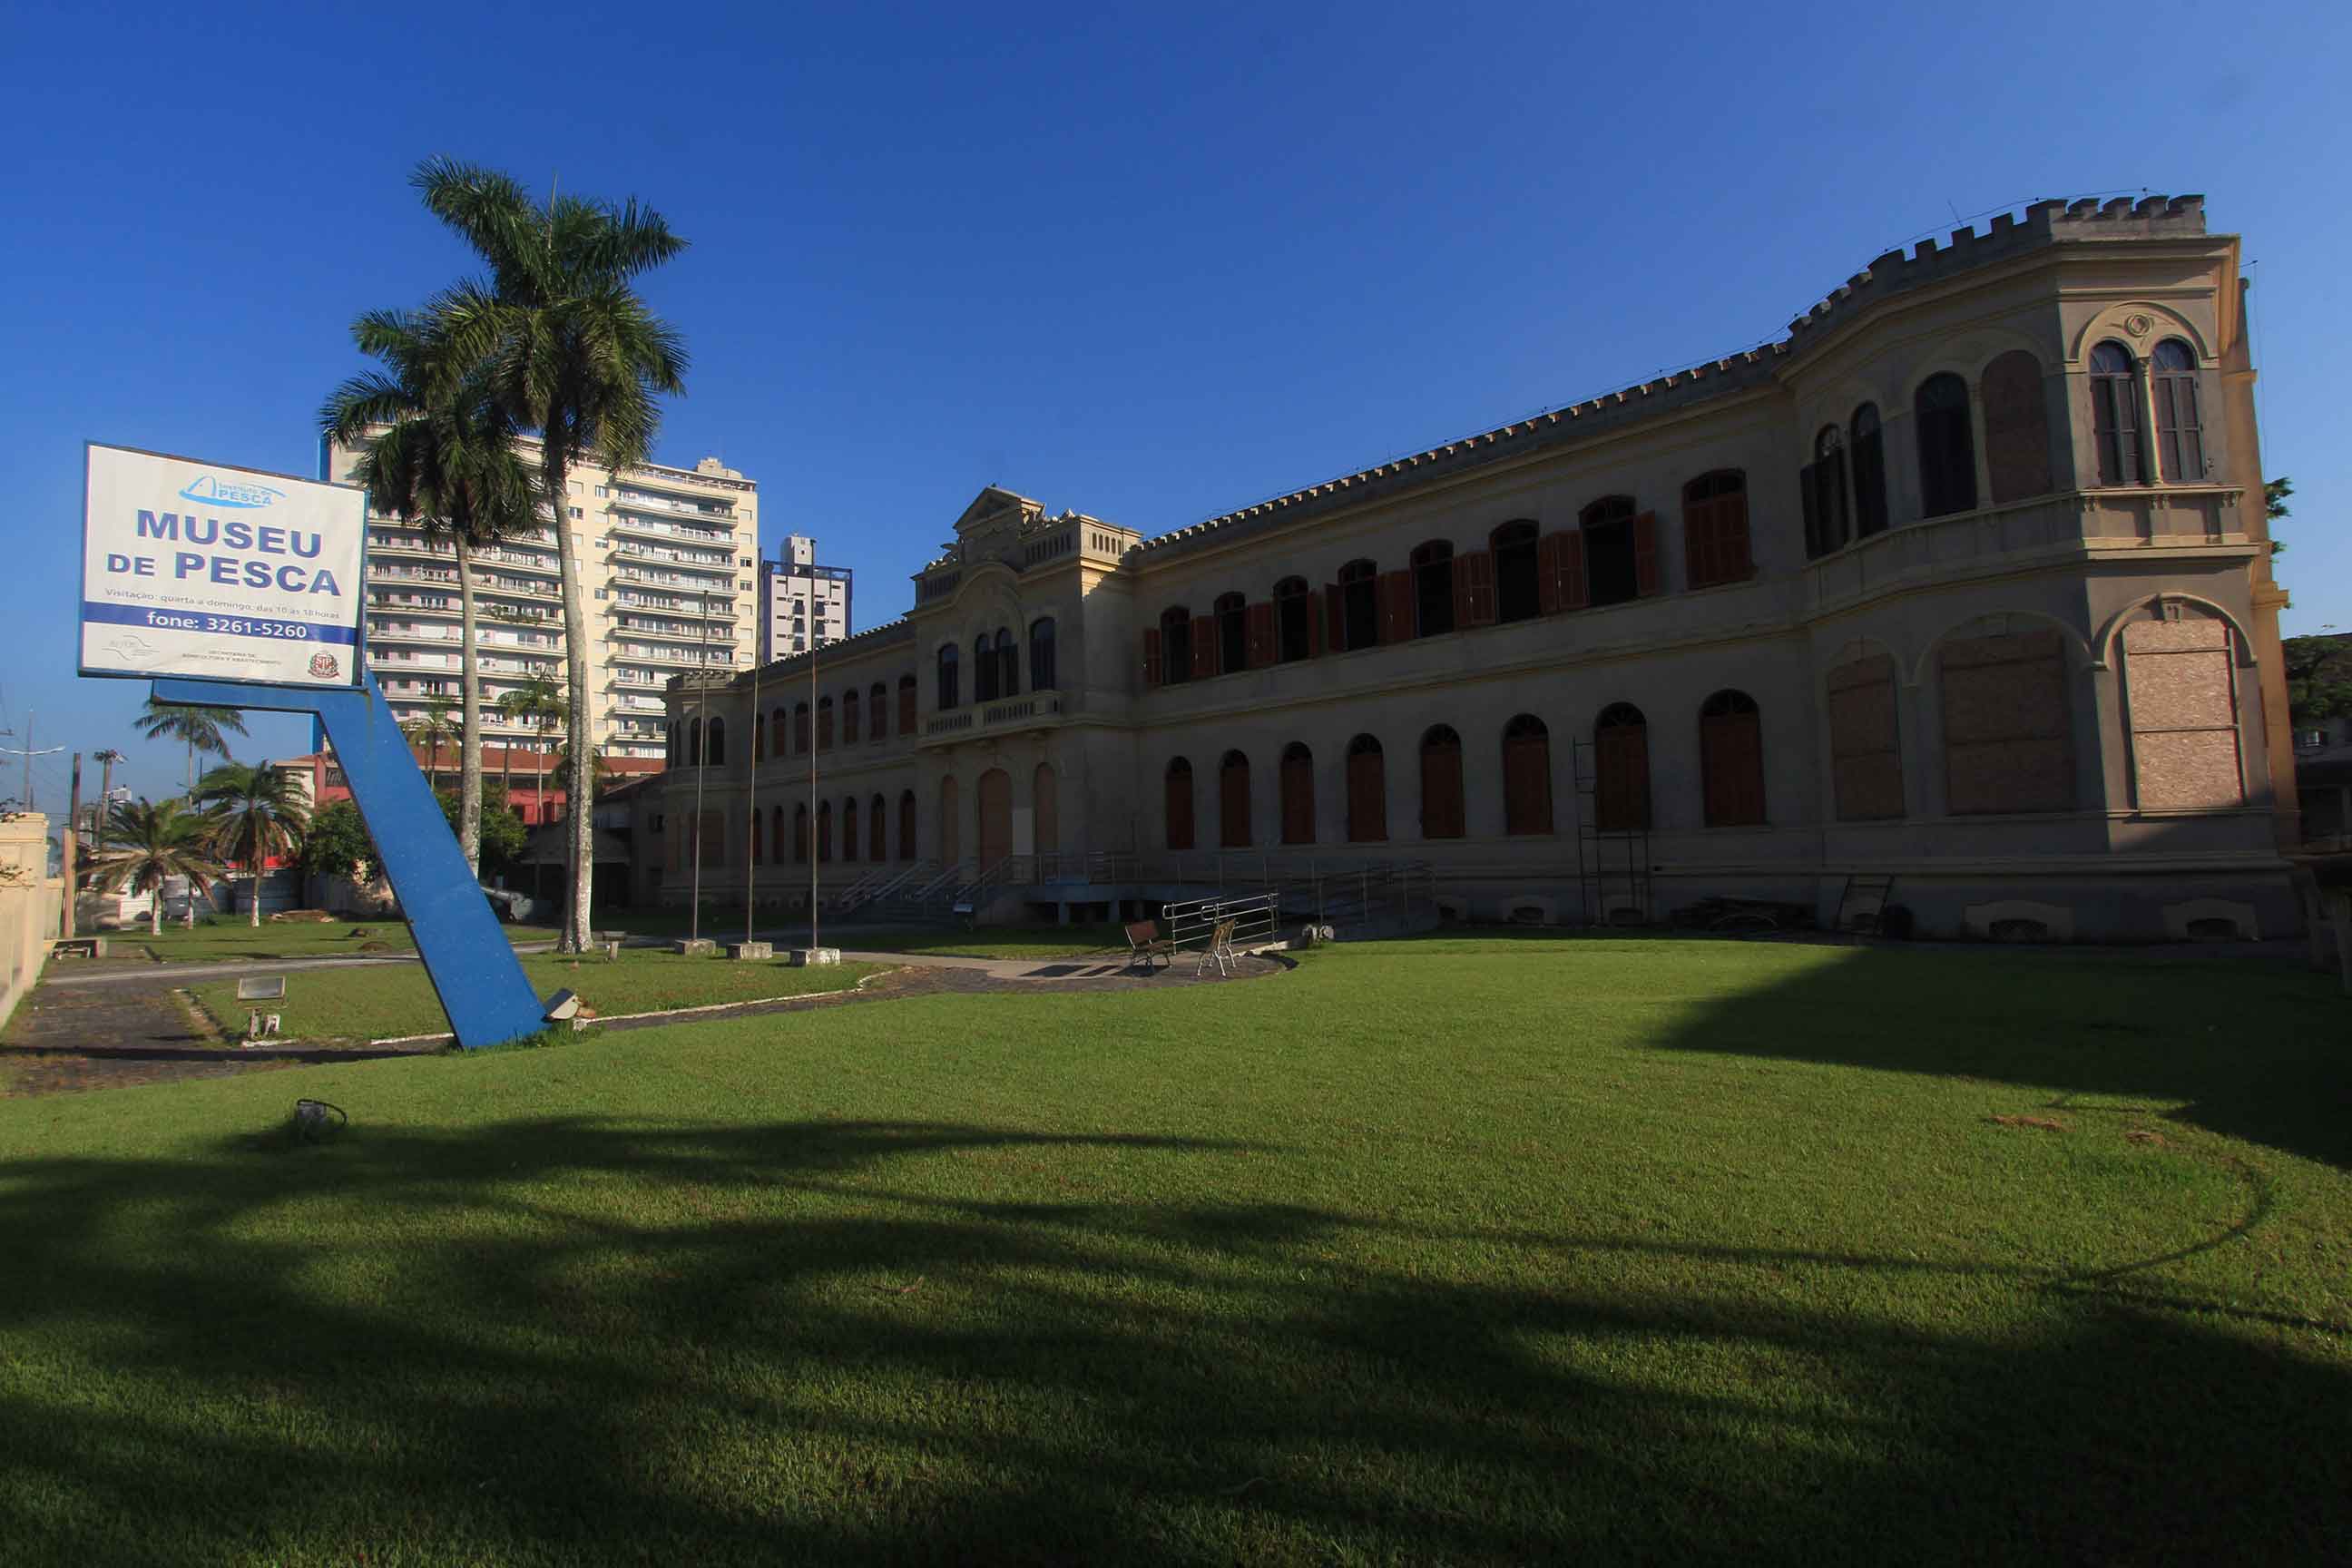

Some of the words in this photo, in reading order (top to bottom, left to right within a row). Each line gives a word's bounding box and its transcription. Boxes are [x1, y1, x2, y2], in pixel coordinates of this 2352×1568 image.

[219, 490, 272, 504] PESCA
[137, 509, 321, 559] MUSEU
[107, 553, 155, 577] DE
[175, 552, 342, 597] PESCA
[161, 594, 195, 605] quarta
[257, 604, 273, 612] das
[147, 611, 199, 630] fone:
[206, 617, 307, 638] 3261-5260
